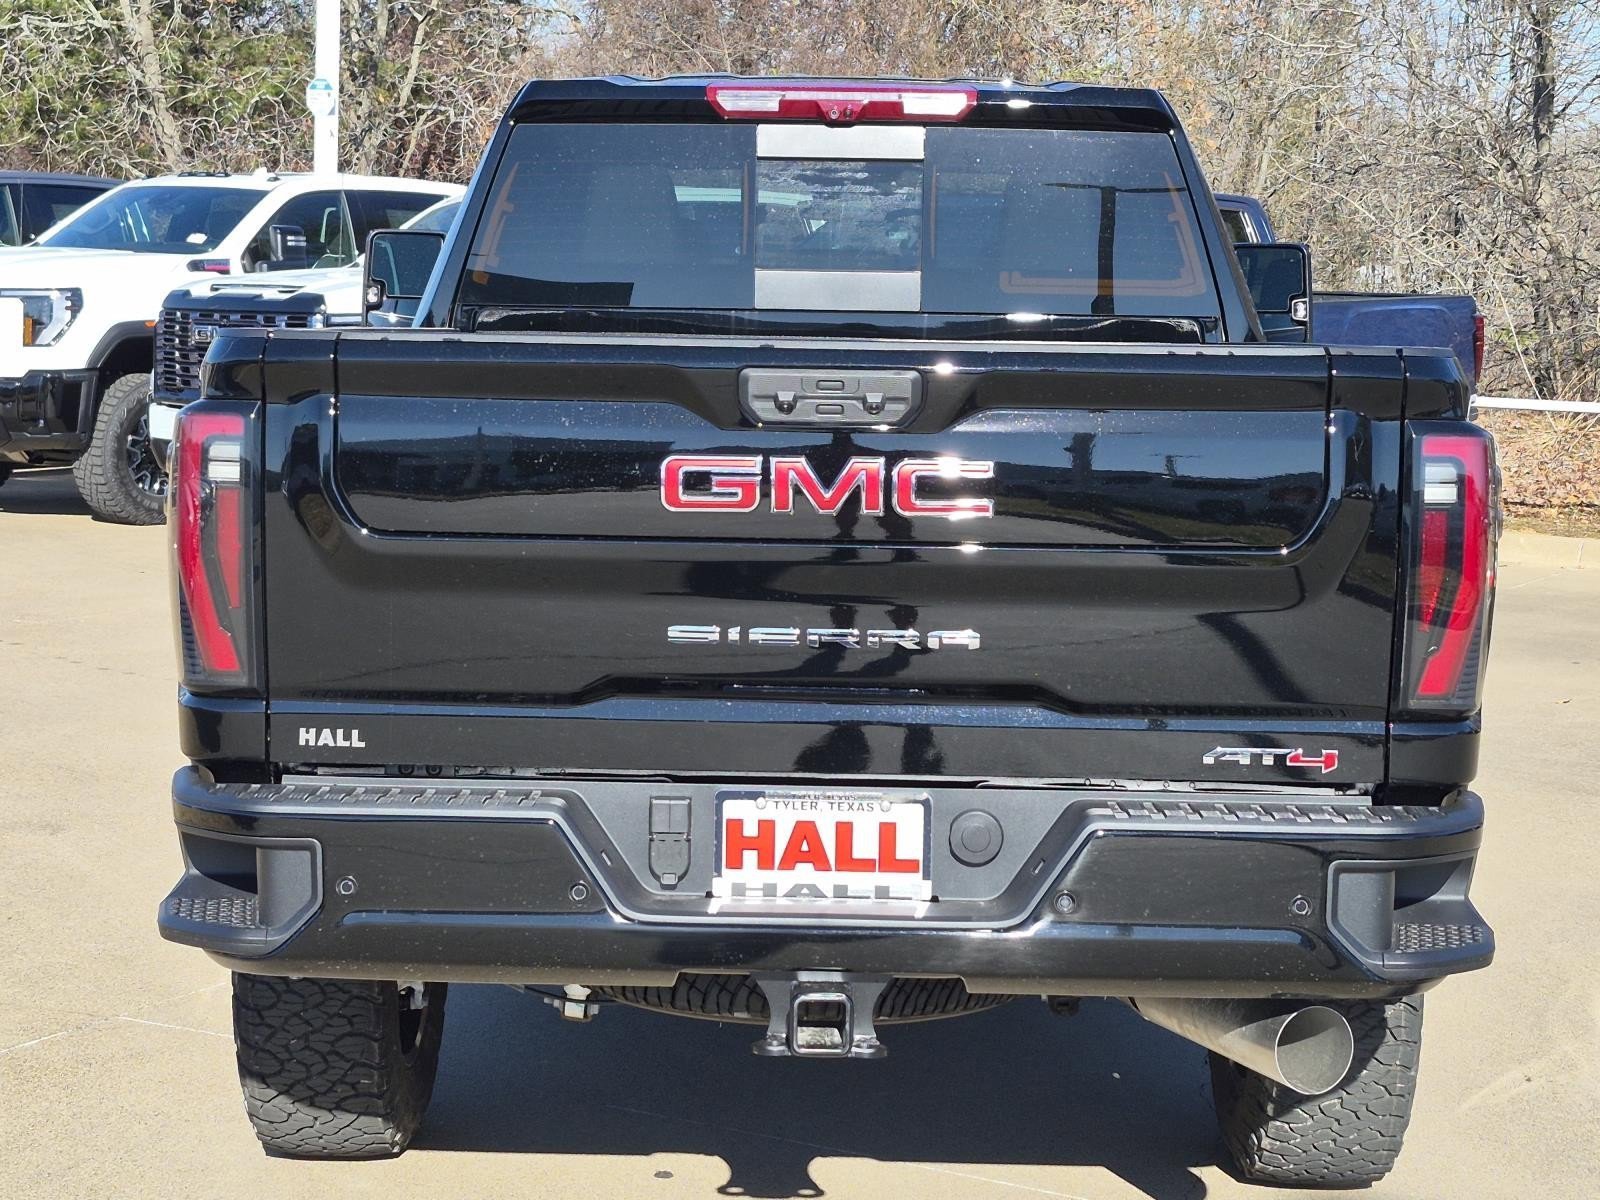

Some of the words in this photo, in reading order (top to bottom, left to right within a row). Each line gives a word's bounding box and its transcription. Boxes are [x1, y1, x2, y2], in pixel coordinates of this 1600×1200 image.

[660, 455, 996, 519] GMC
[667, 624, 982, 651] SIERRA
[299, 727, 366, 748] HALL
[1202, 746, 1339, 774] AT4
[774, 800, 823, 812] TYLER,
[828, 802, 875, 812] TEXAS
[725, 818, 920, 873] HALL
[731, 882, 913, 900] HALL
